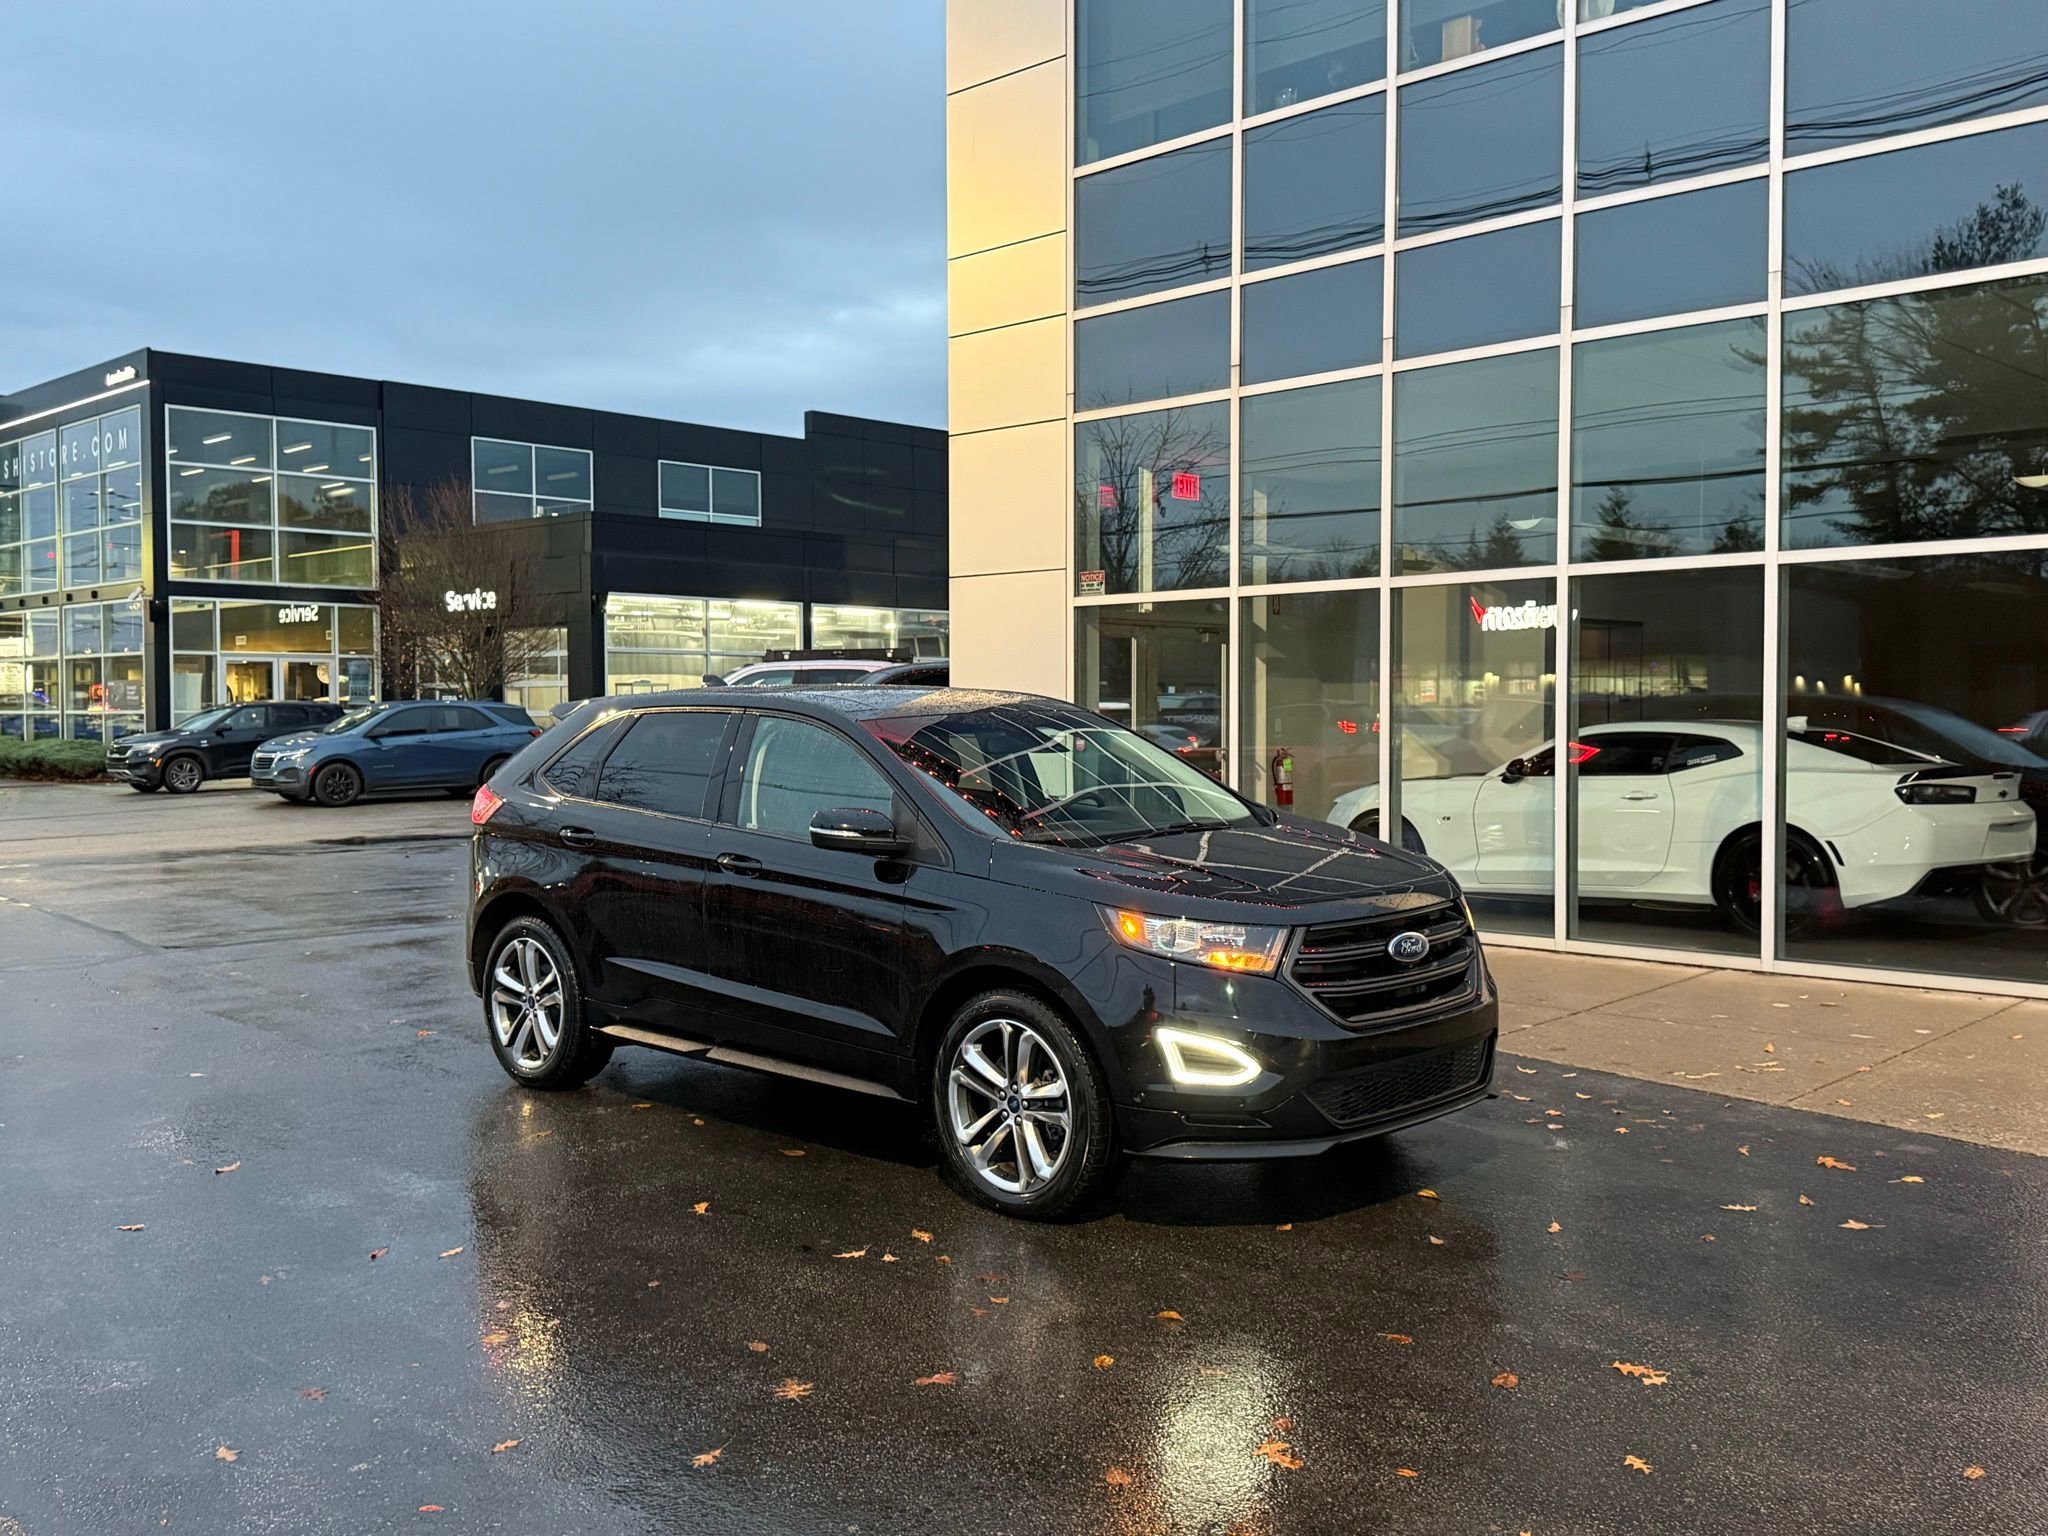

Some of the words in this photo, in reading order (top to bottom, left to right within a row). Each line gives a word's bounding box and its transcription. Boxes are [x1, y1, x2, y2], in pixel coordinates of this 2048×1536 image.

[1177, 476, 1196, 498] EXIT
[1080, 573, 1104, 583] NOTICE
[1400, 938, 1423, 955] Ford
